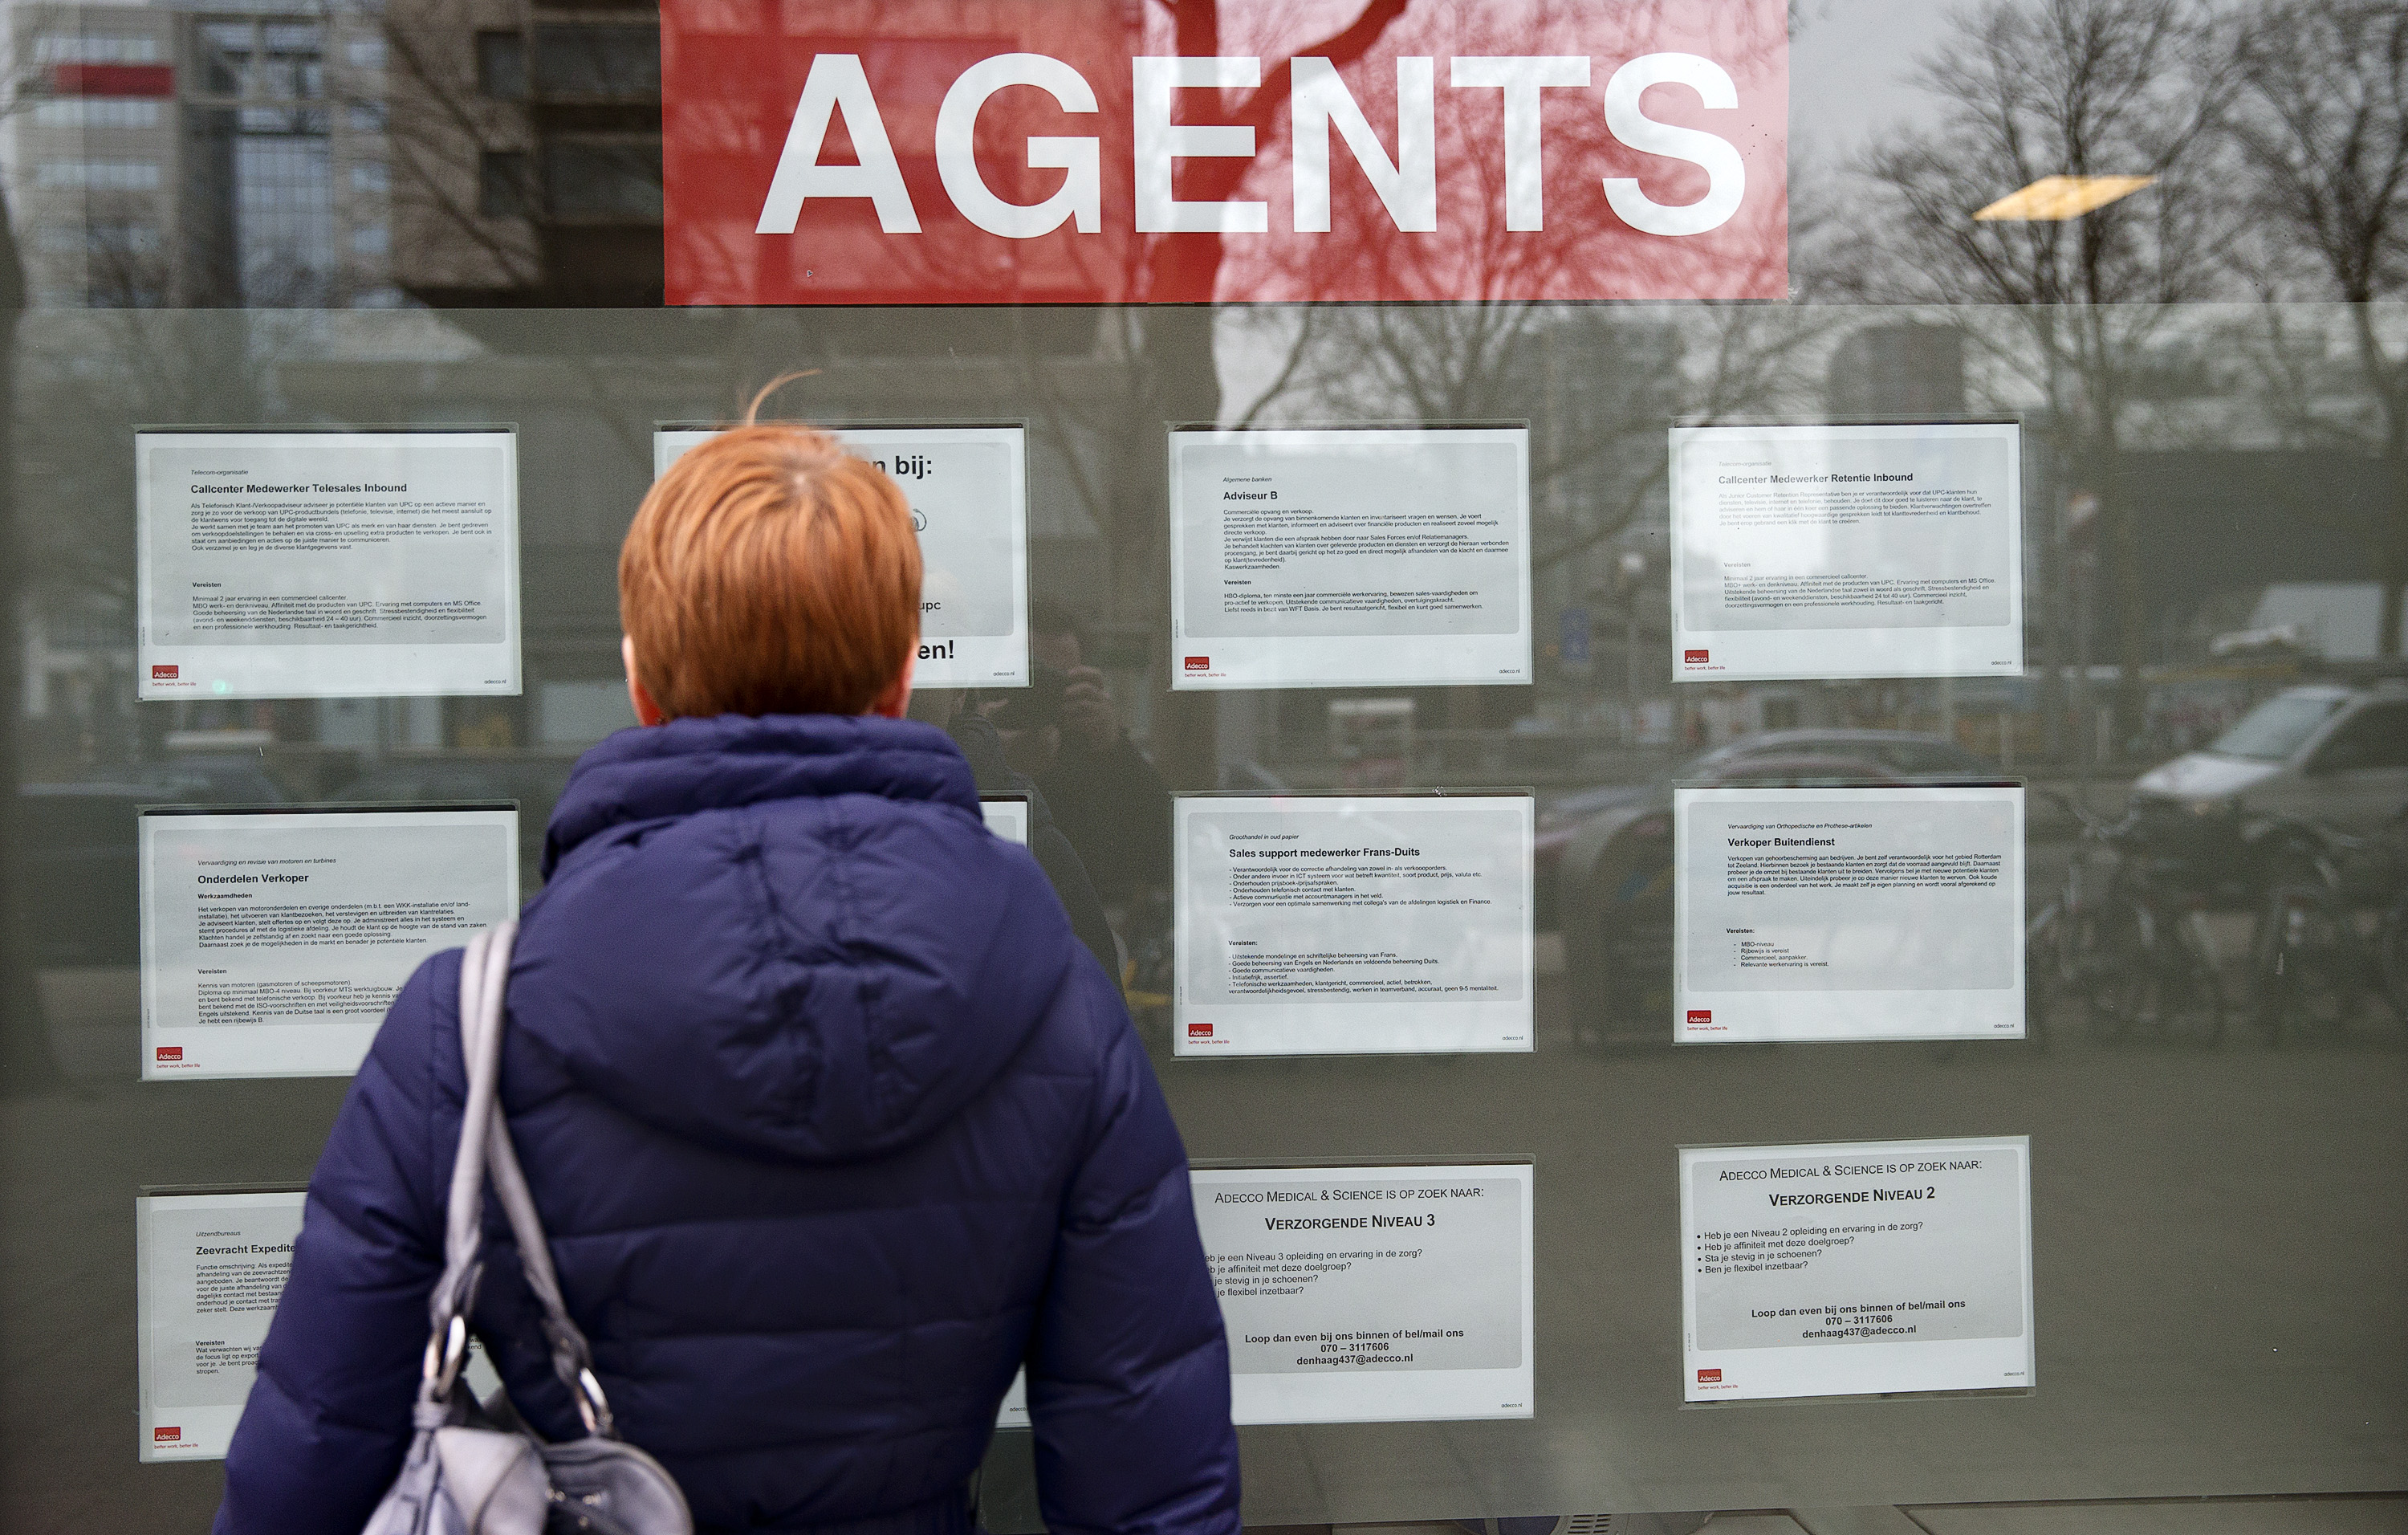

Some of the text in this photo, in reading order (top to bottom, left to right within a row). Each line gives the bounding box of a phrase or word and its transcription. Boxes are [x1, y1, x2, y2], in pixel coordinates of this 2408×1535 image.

[755, 52, 1745, 238] AGENTS
[896, 455, 932, 478] bij:
[1719, 473, 1913, 484] Callcenter Medewerker Retentie Inbound
[191, 483, 407, 494] Callcenter Medewerker Telesales Inbound
[1223, 491, 1278, 500] Adviseur B
[918, 640, 954, 659] en!
[1728, 837, 1835, 849] Verkoper Buitendienst
[1230, 848, 1420, 860] Sales support medewerker Frans-Duits
[198, 874, 309, 884] Onderdelen Verkoper
[158, 1053, 182, 1061] Adecco
[1719, 1160, 1982, 1182] ADECCO MEDICAL & SCIENCE IS OP ZOEK NAAR:
[1215, 1188, 1484, 1203] ADECCO MEDICAL & SCIENCE IS OP ZOEK NAAR:
[1768, 1187, 1935, 1207] VERZORGENDE NIVEAU 2
[1265, 1214, 1435, 1231] VERZORGENDE NIVEAU 3
[1704, 1232, 1722, 1240] Heb
[1723, 1231, 1731, 1241] je
[1751, 1230, 1780, 1238] Niveau
[1783, 1228, 1788, 1236] 2
[1790, 1227, 1827, 1237] opleiding
[1842, 1224, 1875, 1234] ervaring
[1878, 1224, 1885, 1232] in
[1887, 1224, 1898, 1232] de
[1901, 1221, 1923, 1232] zorg?
[196, 1244, 296, 1255] Zeevracht Expedite
[1705, 1243, 1722, 1251] Heb
[1724, 1243, 1732, 1252] je
[1734, 1240, 1766, 1250] affiniteit
[1786, 1240, 1806, 1248] deze
[1808, 1236, 1855, 1248] doelgroep?
[1205, 1255, 1216, 1263] eb
[1218, 1254, 1226, 1264] je
[1247, 1253, 1275, 1261] Niveau
[1278, 1252, 1283, 1260] 3
[1286, 1252, 1324, 1262] opleiding
[1340, 1250, 1373, 1260] ervaring
[1376, 1250, 1384, 1258] in
[1399, 1248, 1422, 1259] zorg?
[1705, 1255, 1719, 1263] Sta
[1721, 1254, 1729, 1264] je
[1731, 1253, 1755, 1262] stevig
[1767, 1252, 1775, 1261] je
[1777, 1249, 1822, 1259] schoenen?
[1218, 1265, 1226, 1276] je
[1228, 1264, 1261, 1273] affiniteit
[1263, 1264, 1279, 1272] met
[1281, 1264, 1302, 1272] deze
[1304, 1262, 1352, 1272] doelgroep?
[1706, 1261, 1808, 1275] Ben je flexibel inzetbaar?
[1214, 1277, 1222, 1286] je
[1225, 1276, 1250, 1286] stevig
[1262, 1276, 1270, 1286] je
[1272, 1274, 1319, 1284] schoenen?
[1217, 1286, 1304, 1298] je flexibel inzetbaar?
[1751, 1309, 1776, 1319] Loop
[1779, 1308, 1796, 1317] dan
[1825, 1305, 1837, 1316] bij
[1861, 1304, 1893, 1313] binnen
[1896, 1302, 1906, 1311] of
[1909, 1301, 1946, 1310] bel/mail
[1826, 1317, 1842, 1325] 070
[1854, 1314, 1893, 1325] 3117606
[1245, 1335, 1270, 1345] Loop
[1273, 1334, 1291, 1342] dan
[1321, 1333, 1332, 1343] bij
[1357, 1331, 1389, 1340] binnen
[1393, 1330, 1403, 1339] of
[1405, 1329, 1443, 1338] bel/mail
[1803, 1325, 1917, 1339] denhaag437@adecco.nl
[1321, 1342, 1338, 1353] 070
[1349, 1342, 1389, 1352] 3117606
[1296, 1354, 1413, 1366] denhaag437@adecco.nl
